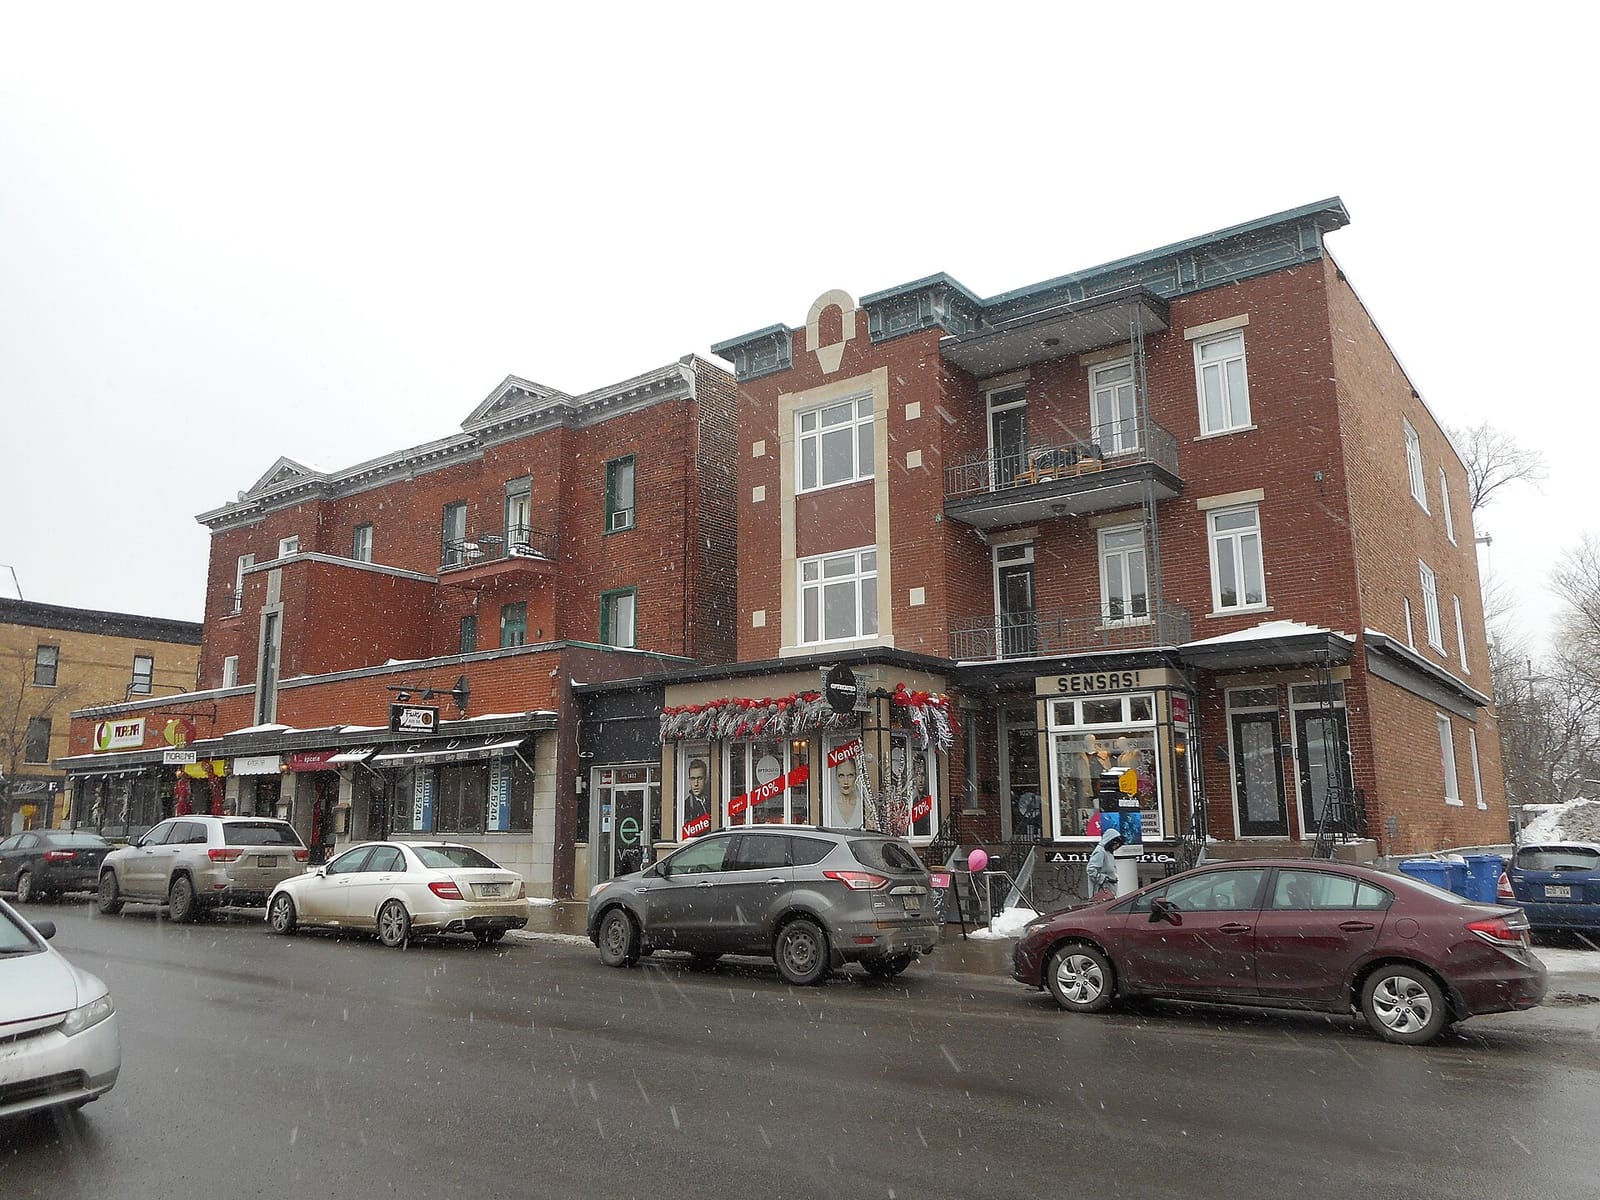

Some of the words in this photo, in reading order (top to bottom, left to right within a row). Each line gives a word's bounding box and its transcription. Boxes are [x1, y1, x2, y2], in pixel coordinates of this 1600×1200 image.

[1058, 671, 1141, 692] SENSAS!
[829, 742, 862, 764] Vente
[755, 780, 779, 801] 70%
[913, 800, 930, 818] 70%
[683, 819, 710, 836] Vente
